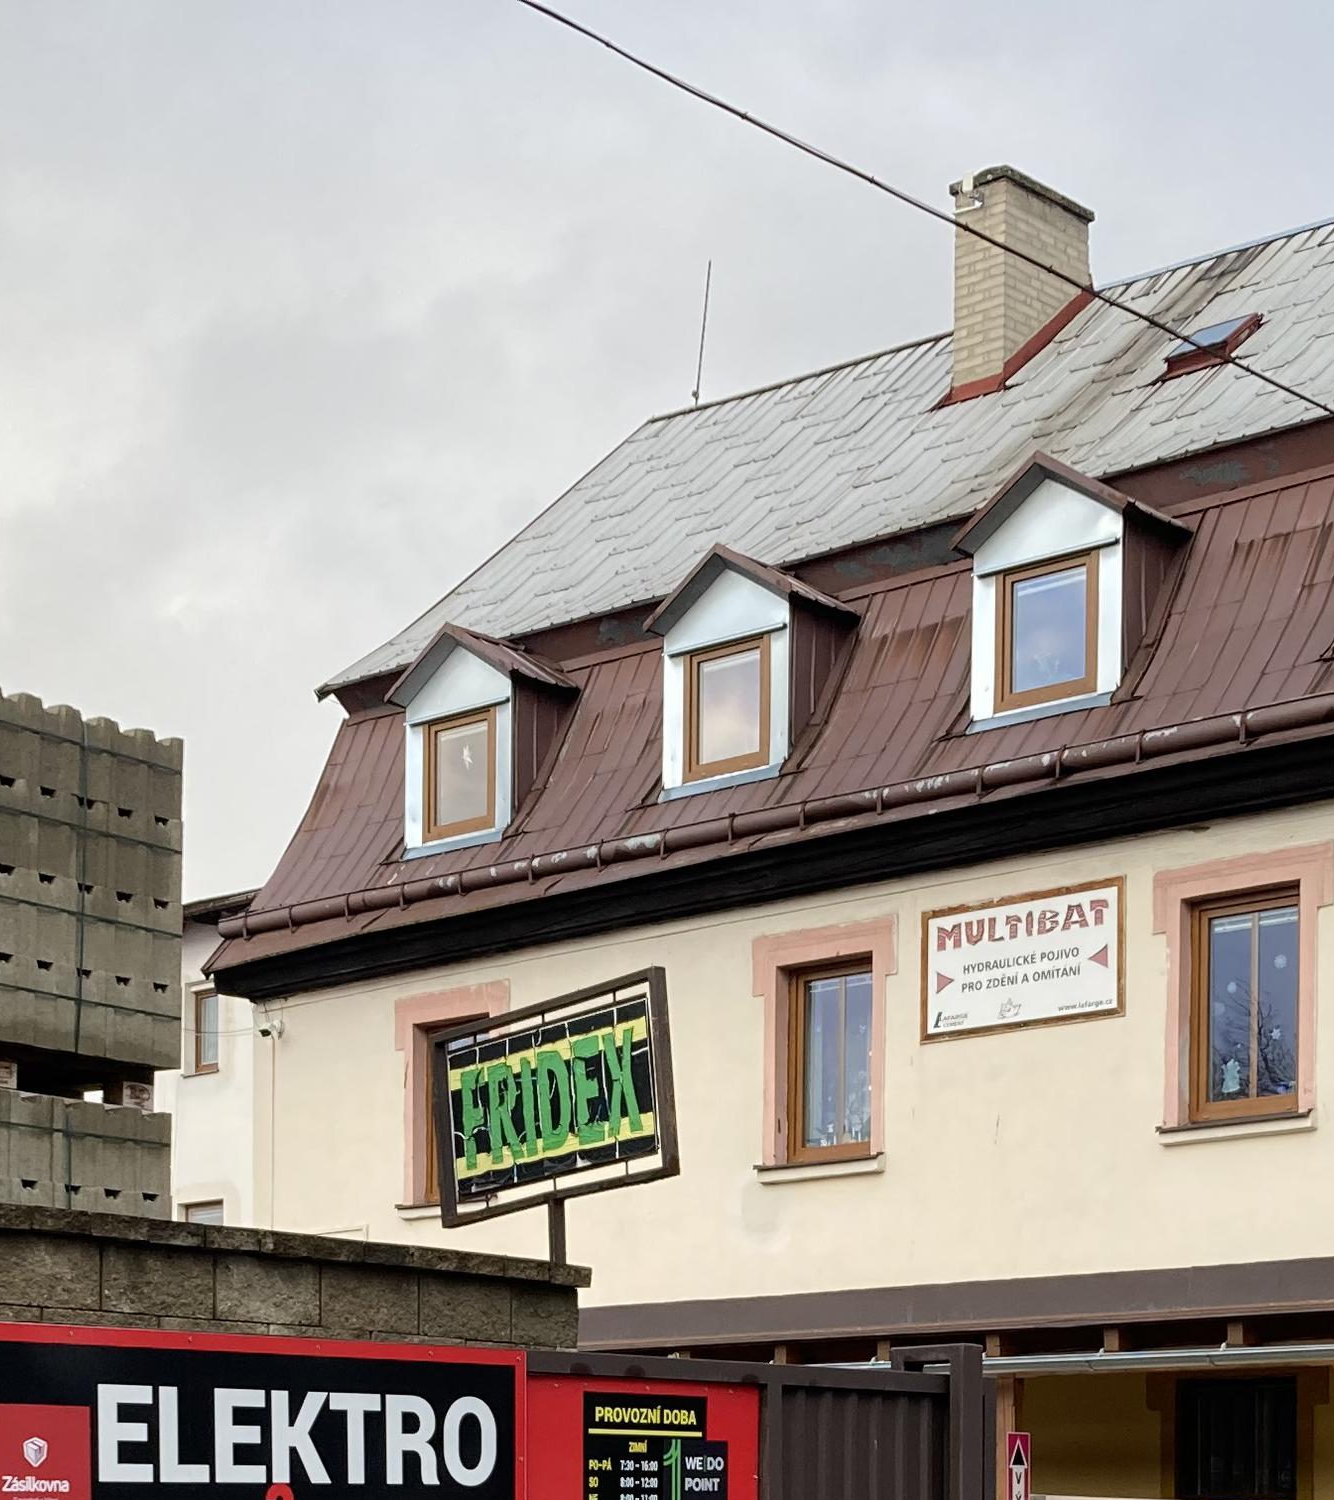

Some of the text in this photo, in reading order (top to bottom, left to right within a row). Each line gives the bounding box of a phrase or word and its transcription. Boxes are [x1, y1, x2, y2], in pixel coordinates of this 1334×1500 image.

[937, 899, 1109, 952] MULTIBAT
[963, 947, 1080, 975] HYDRAULICKÉ POJIVO
[961, 980, 983, 993] PRO
[1021, 973, 1030, 984] A
[1032, 962, 1081, 982] OMÍTÁNÍ
[461, 1026, 643, 1170] FRIDEX
[595, 1405, 697, 1426] PROVOZNÍ DOBA
[97, 1383, 497, 1487] ELEKTRO
[1, 1475, 70, 1493] Zásilkovna
[684, 1477, 720, 1491] POINT
